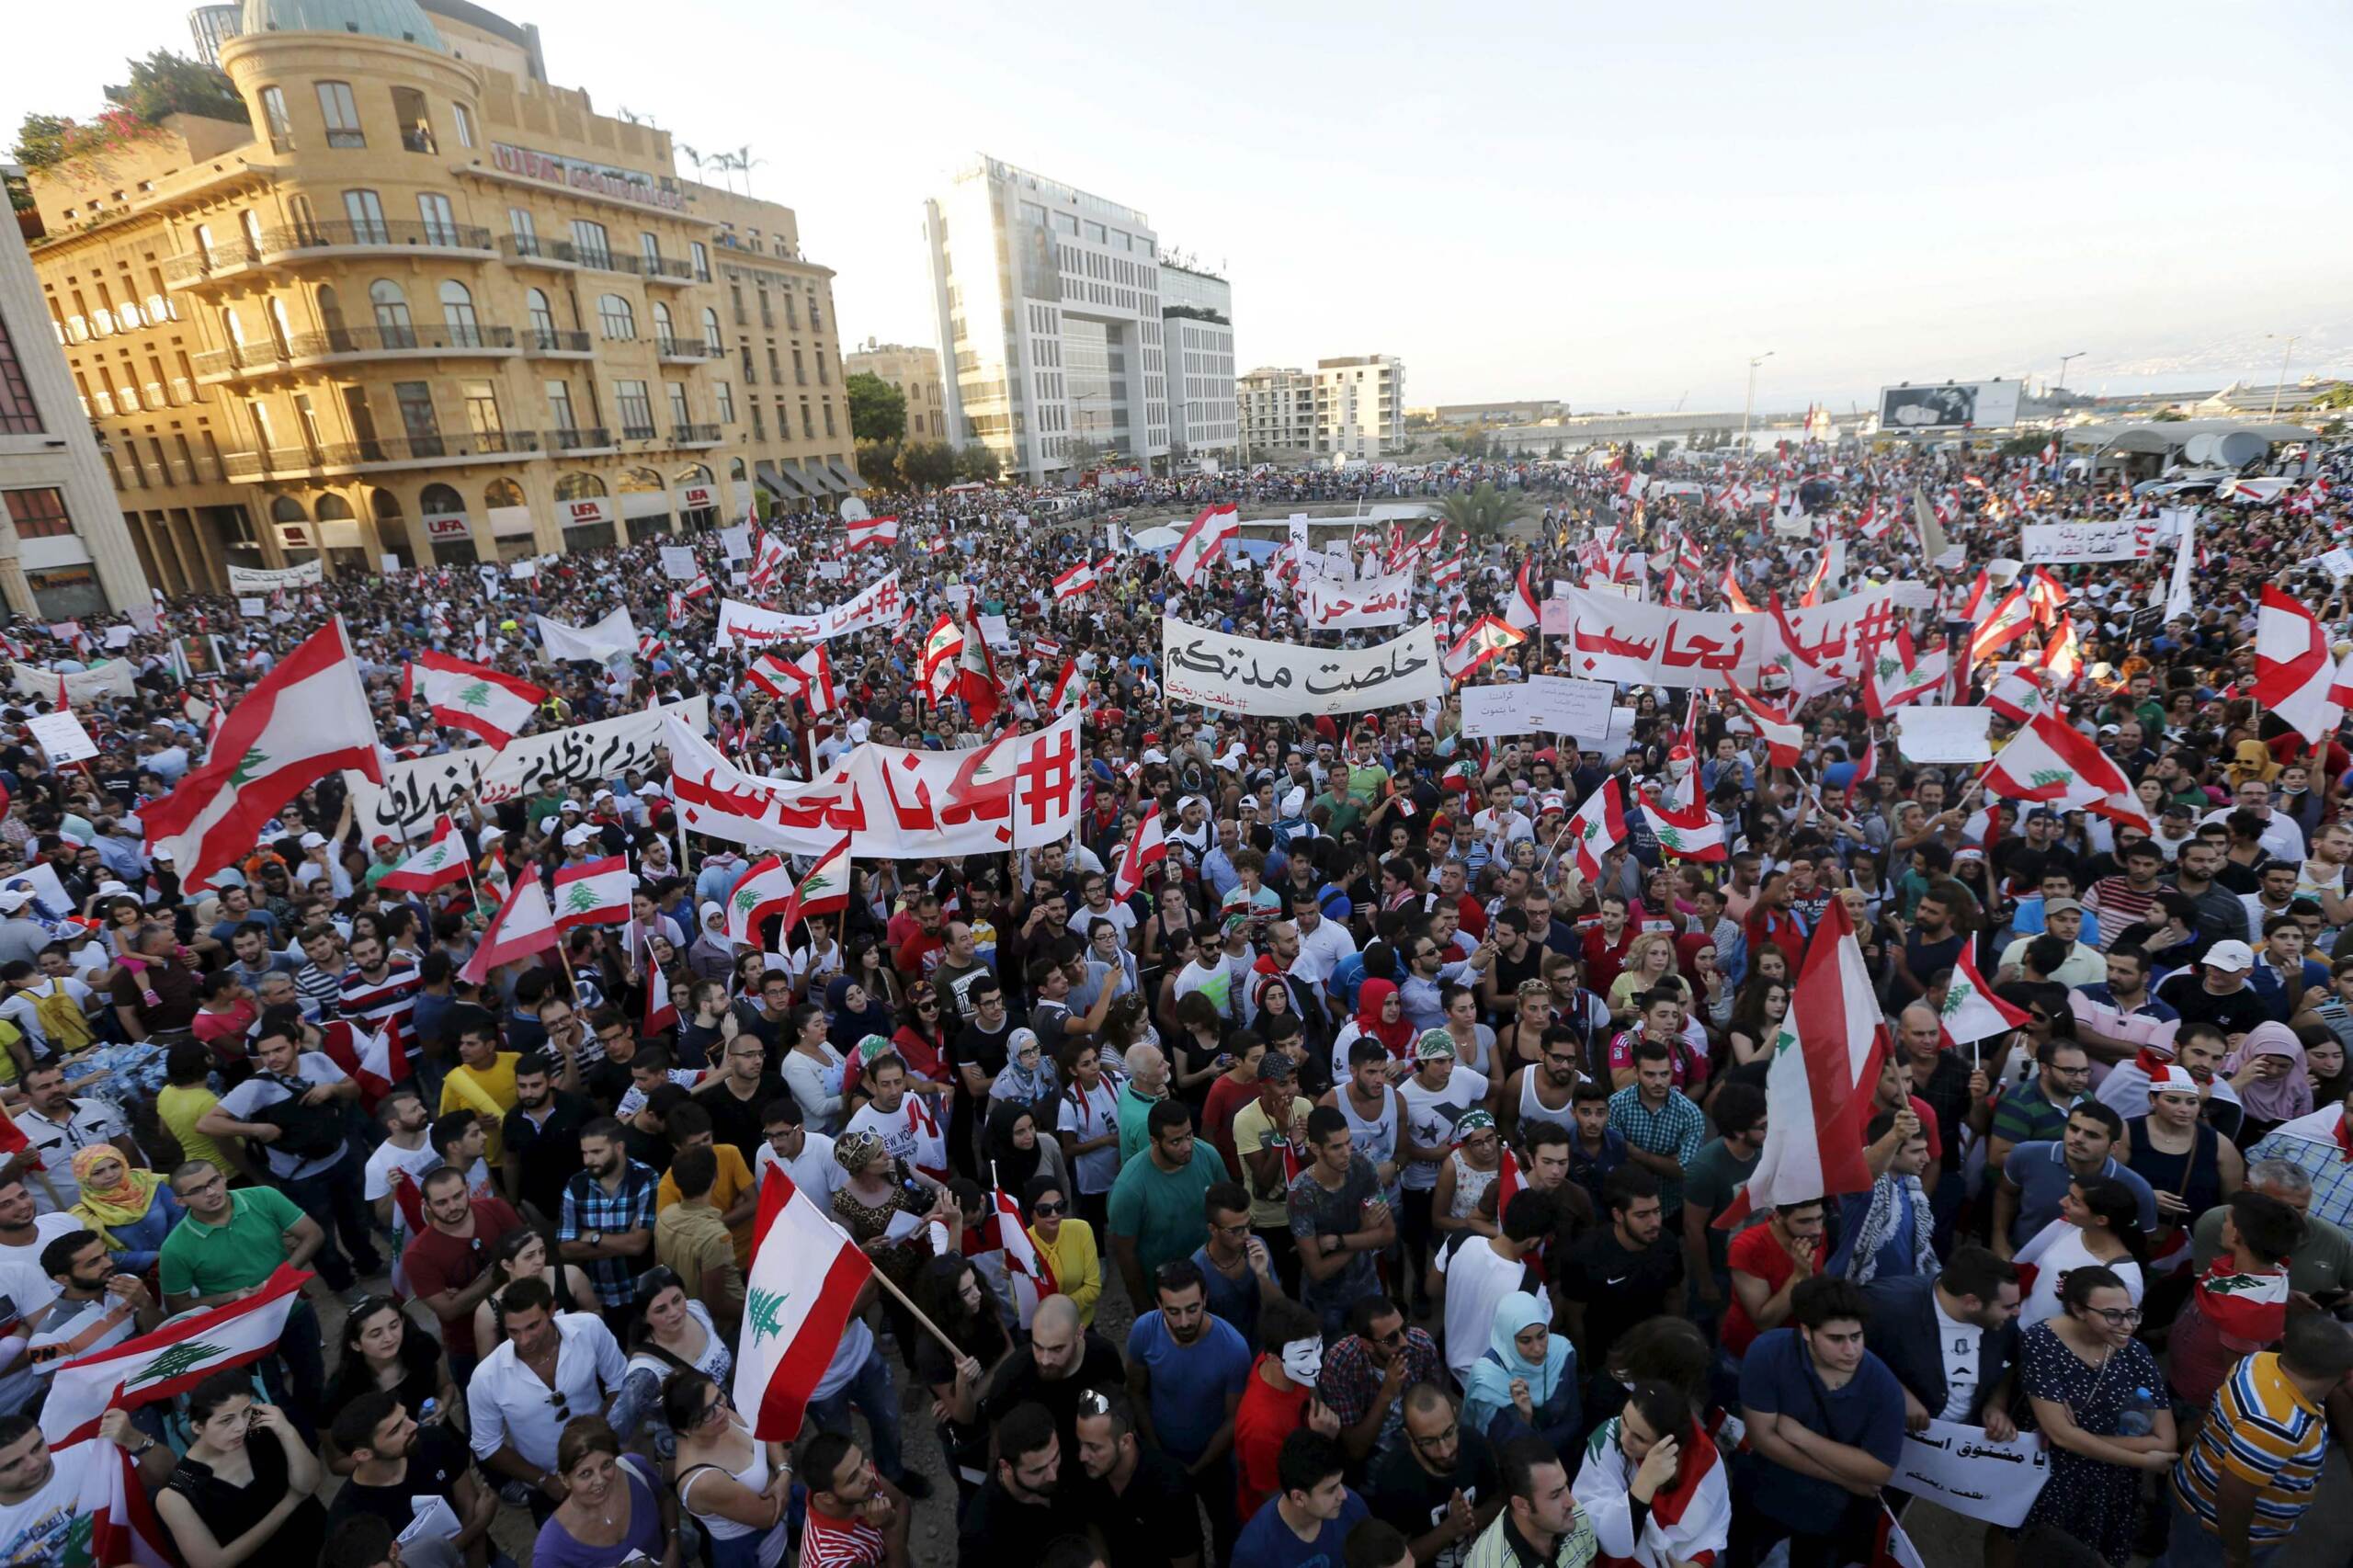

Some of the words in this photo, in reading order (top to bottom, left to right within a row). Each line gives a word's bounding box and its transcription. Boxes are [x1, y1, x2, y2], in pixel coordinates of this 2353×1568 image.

[570, 502, 599, 517] UFA
[685, 489, 710, 502] UFA
[428, 518, 466, 533] UFA
[1574, 618, 1745, 672] نحاسب
[1165, 640, 1293, 689] مدتكم
[1304, 642, 1428, 696] خلصت
[519, 731, 594, 799] نظام
[669, 754, 868, 832] نحاسب
[1956, 1439, 2025, 1464] مشنوق
[2032, 1450, 2046, 1471] يا
